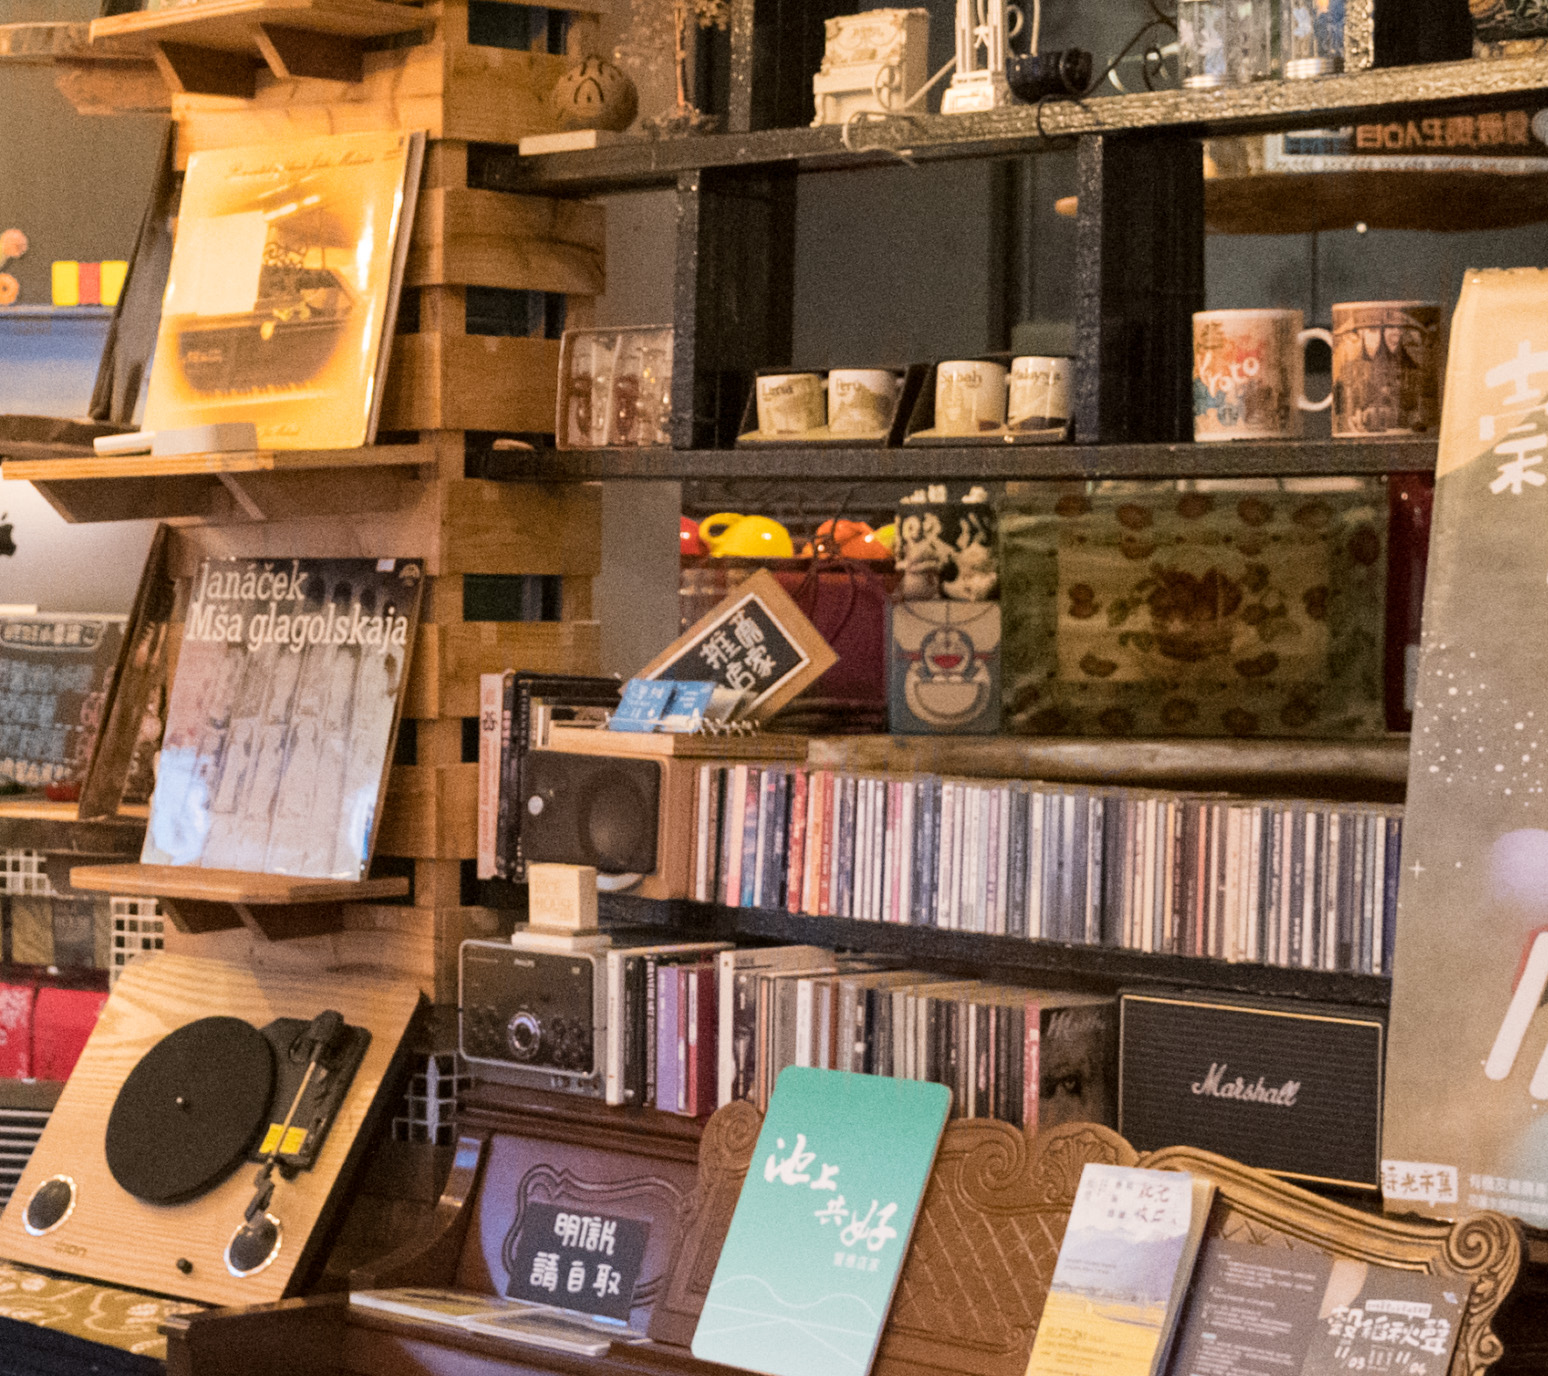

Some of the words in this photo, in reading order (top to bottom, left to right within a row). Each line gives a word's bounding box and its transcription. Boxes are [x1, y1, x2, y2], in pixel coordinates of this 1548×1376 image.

[193, 562, 308, 605] Janáček
[185, 604, 245, 648] Mša
[247, 610, 409, 654] glagolskaja
[1191, 1062, 1301, 1106] Marshall
[763, 1132, 841, 1192] 池上
[553, 1212, 618, 1257] 明信片
[813, 1193, 899, 1252] 共好
[529, 1250, 622, 1299] 請自取
